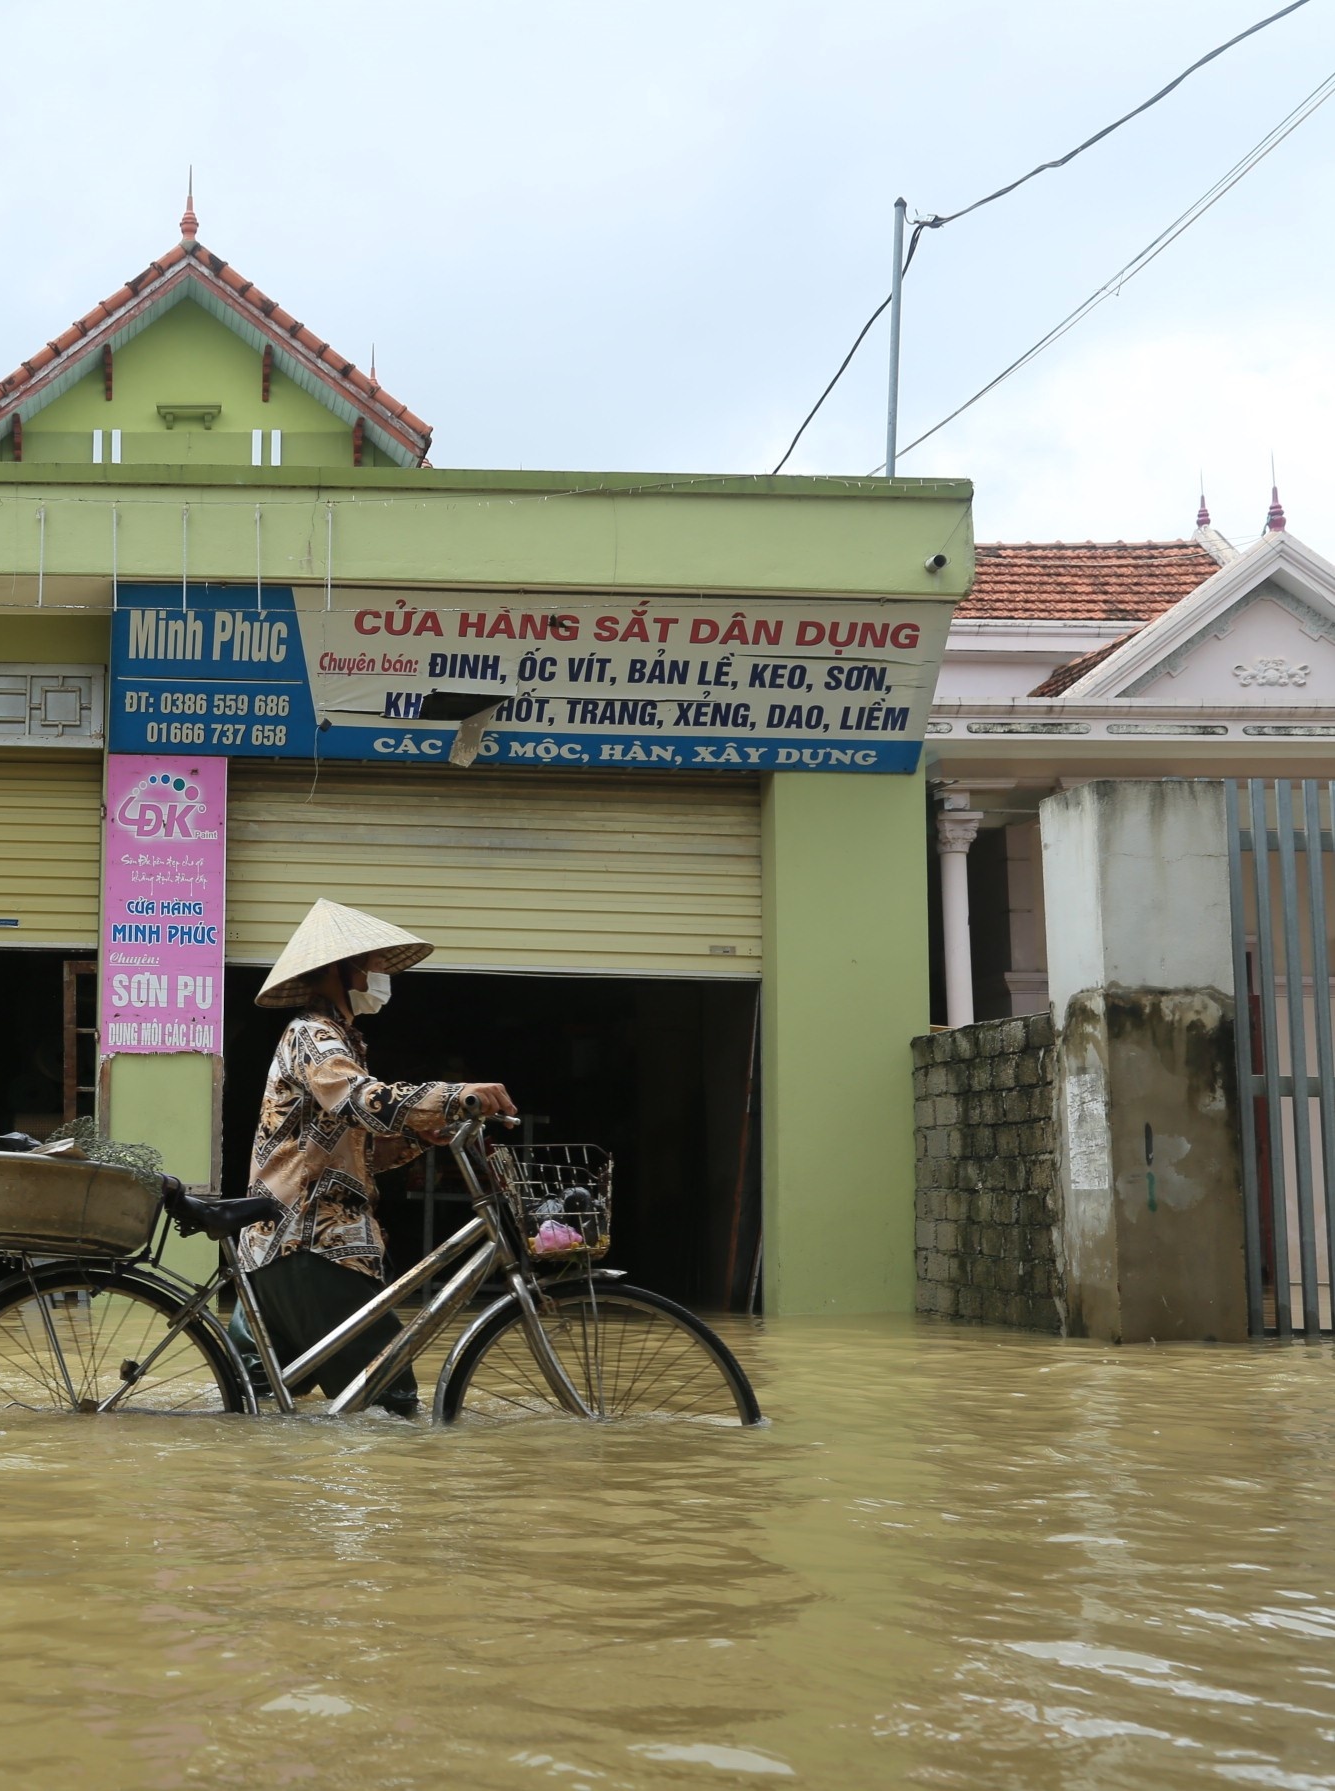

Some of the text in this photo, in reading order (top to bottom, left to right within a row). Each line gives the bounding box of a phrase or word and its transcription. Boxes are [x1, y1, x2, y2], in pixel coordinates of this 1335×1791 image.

[128, 609, 288, 663] Minh Phúc
[354, 599, 920, 655] CỬA HÀNG SẮT DÂN DỤNG
[319, 647, 892, 695] Chuyên bán: ĐINH, ỐC VÍT, BẢN LỀ, KEO, SƠN,
[125, 691, 290, 717] ĐT: 0386 559 686
[490, 687, 555, 726] HỐT,
[566, 699, 664, 729] TRANG,
[673, 690, 757, 732] XẺNG,
[766, 703, 830, 733] DAO,
[840, 697, 910, 731] LIỀM
[147, 722, 287, 746] 01666 737 658
[373, 734, 443, 755] CÁC
[509, 737, 590, 763] MỘC,
[599, 740, 683, 765] HÀN,
[692, 742, 768, 765] XÂY
[774, 747, 878, 768] DỰNG
[195, 830, 218, 839] Paint
[126, 896, 203, 916] CỬA HÀNG
[112, 921, 217, 947] MINH PHÚC
[109, 952, 160, 965] Chuyên:
[112, 972, 213, 1009] SƠN PU
[108, 1022, 138, 1046] DUNG
[141, 1017, 163, 1046] MÔI
[165, 1018, 187, 1047] CÁC
